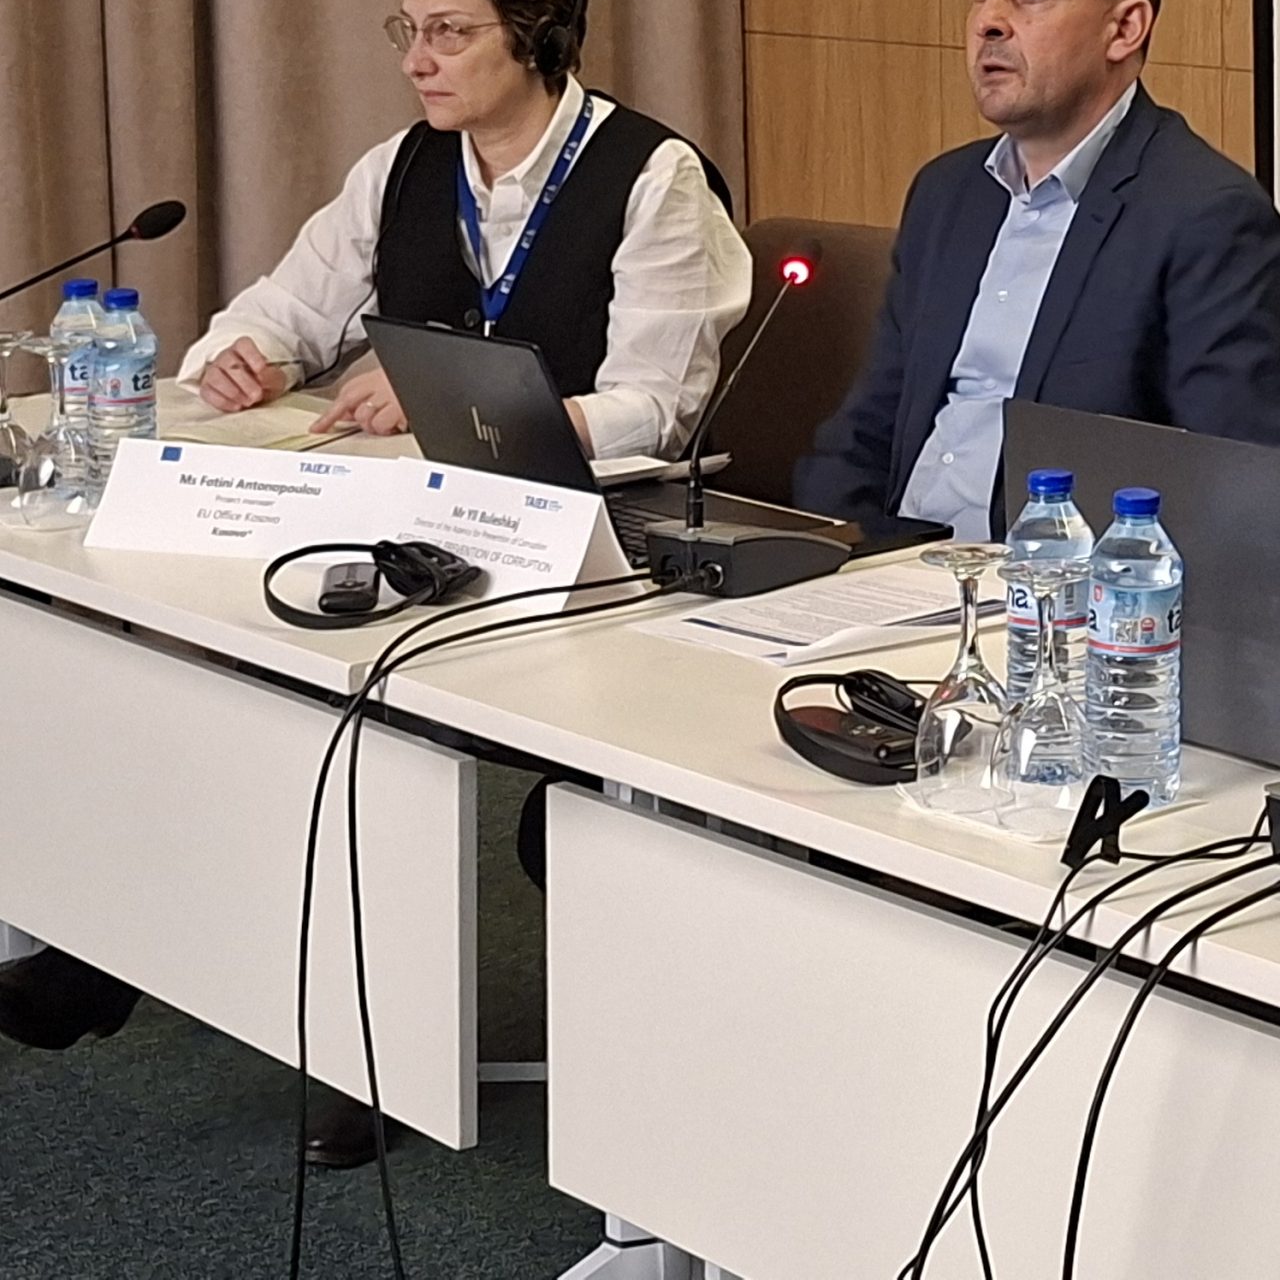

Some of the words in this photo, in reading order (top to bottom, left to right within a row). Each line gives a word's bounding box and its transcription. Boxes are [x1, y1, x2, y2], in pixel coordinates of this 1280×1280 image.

[471, 406, 501, 459] hp
[299, 462, 331, 475] TAIEX
[179, 474, 196, 485] Ms
[524, 495, 549, 510] TAIEX
[197, 508, 212, 519] EU
[213, 509, 242, 522] Office
[451, 505, 465, 518] Mr
